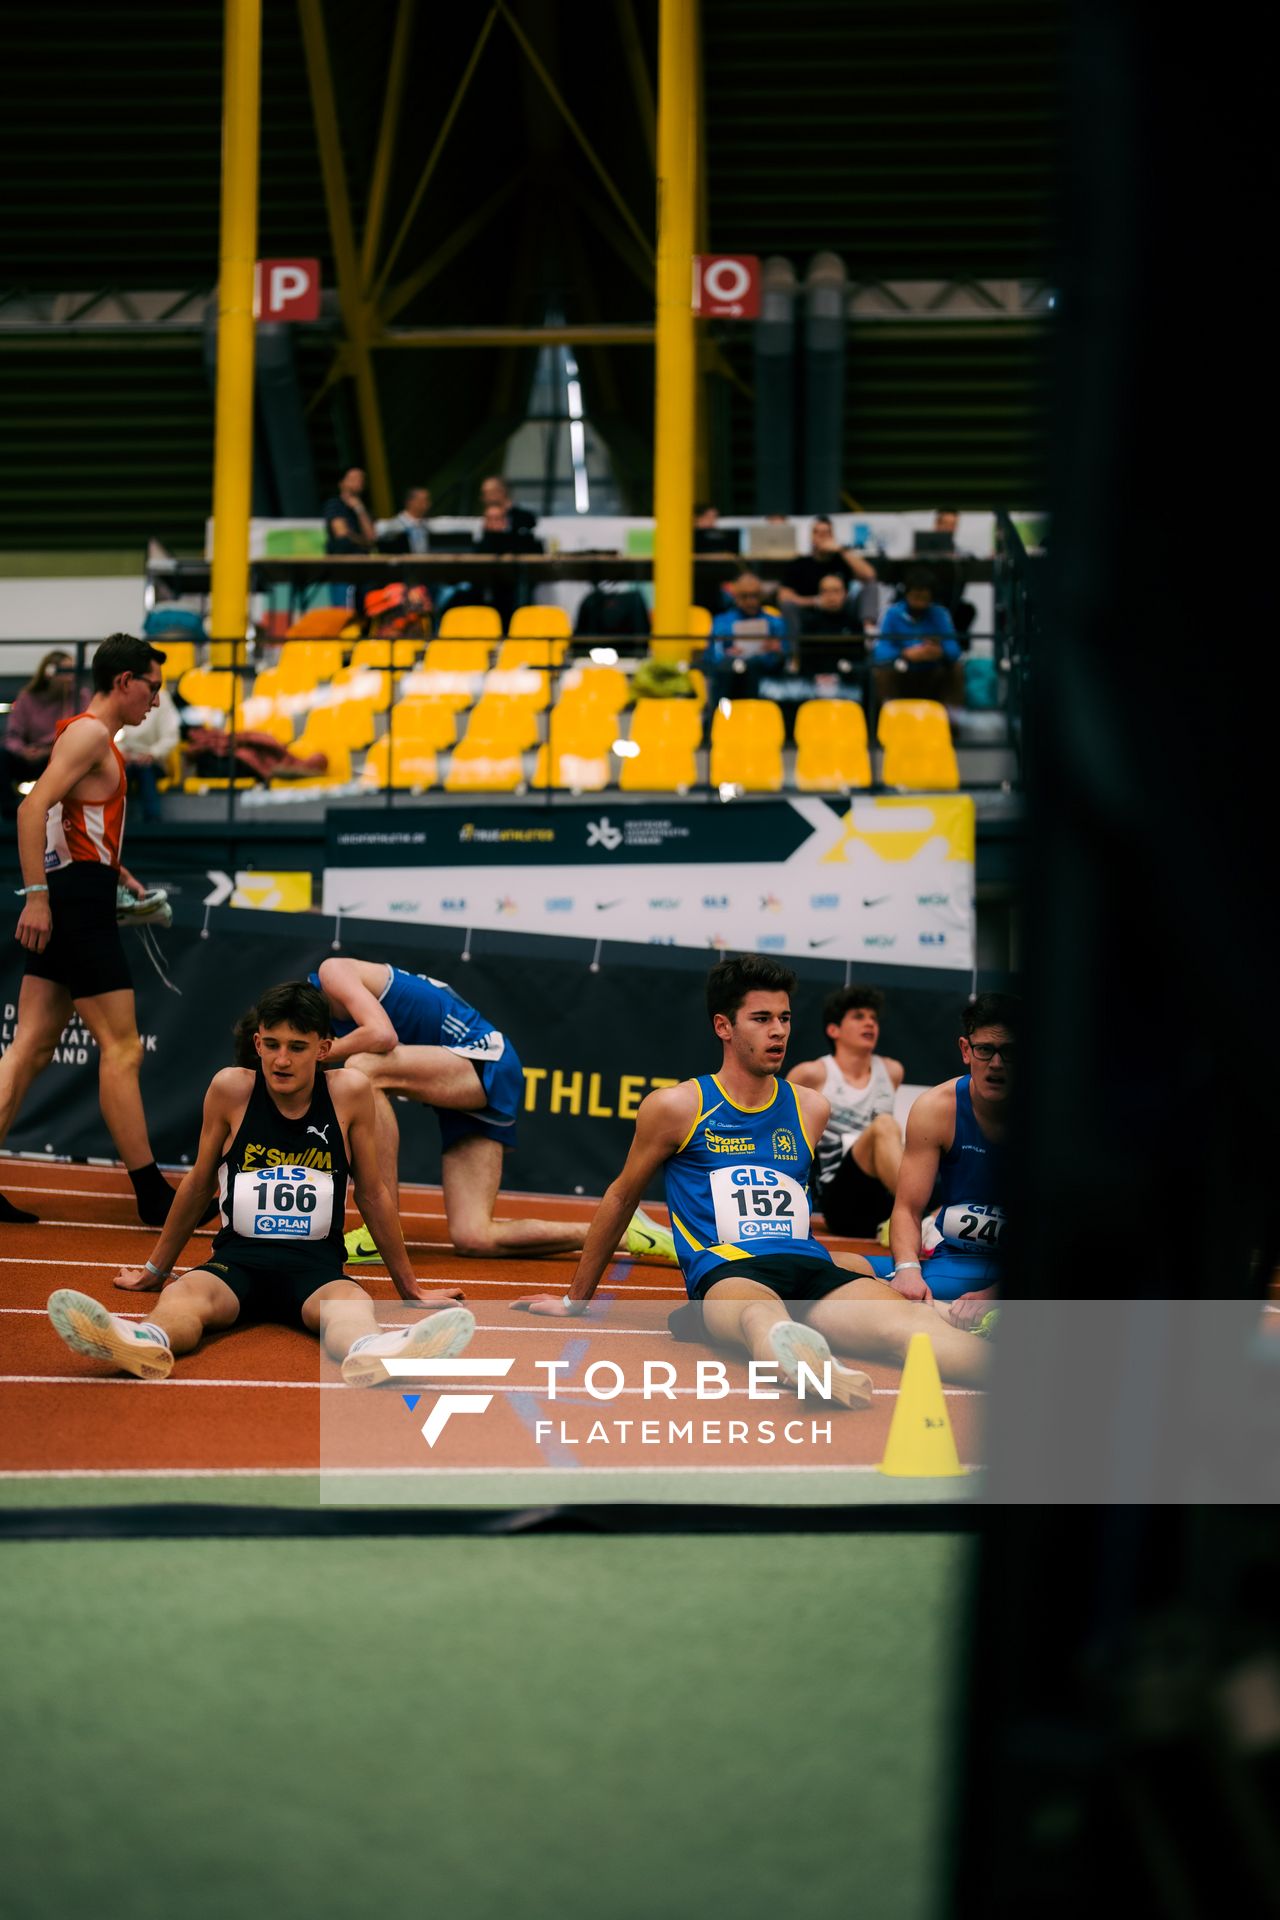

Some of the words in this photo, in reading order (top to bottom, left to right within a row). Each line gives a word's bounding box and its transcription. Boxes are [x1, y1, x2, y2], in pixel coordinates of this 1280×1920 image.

[270, 266, 310, 312] P
[704, 259, 751, 302] O
[253, 1183, 317, 1213] 166
[731, 1189, 795, 1217] 152
[278, 1219, 309, 1230] PLAN
[761, 1222, 791, 1232] PLAN
